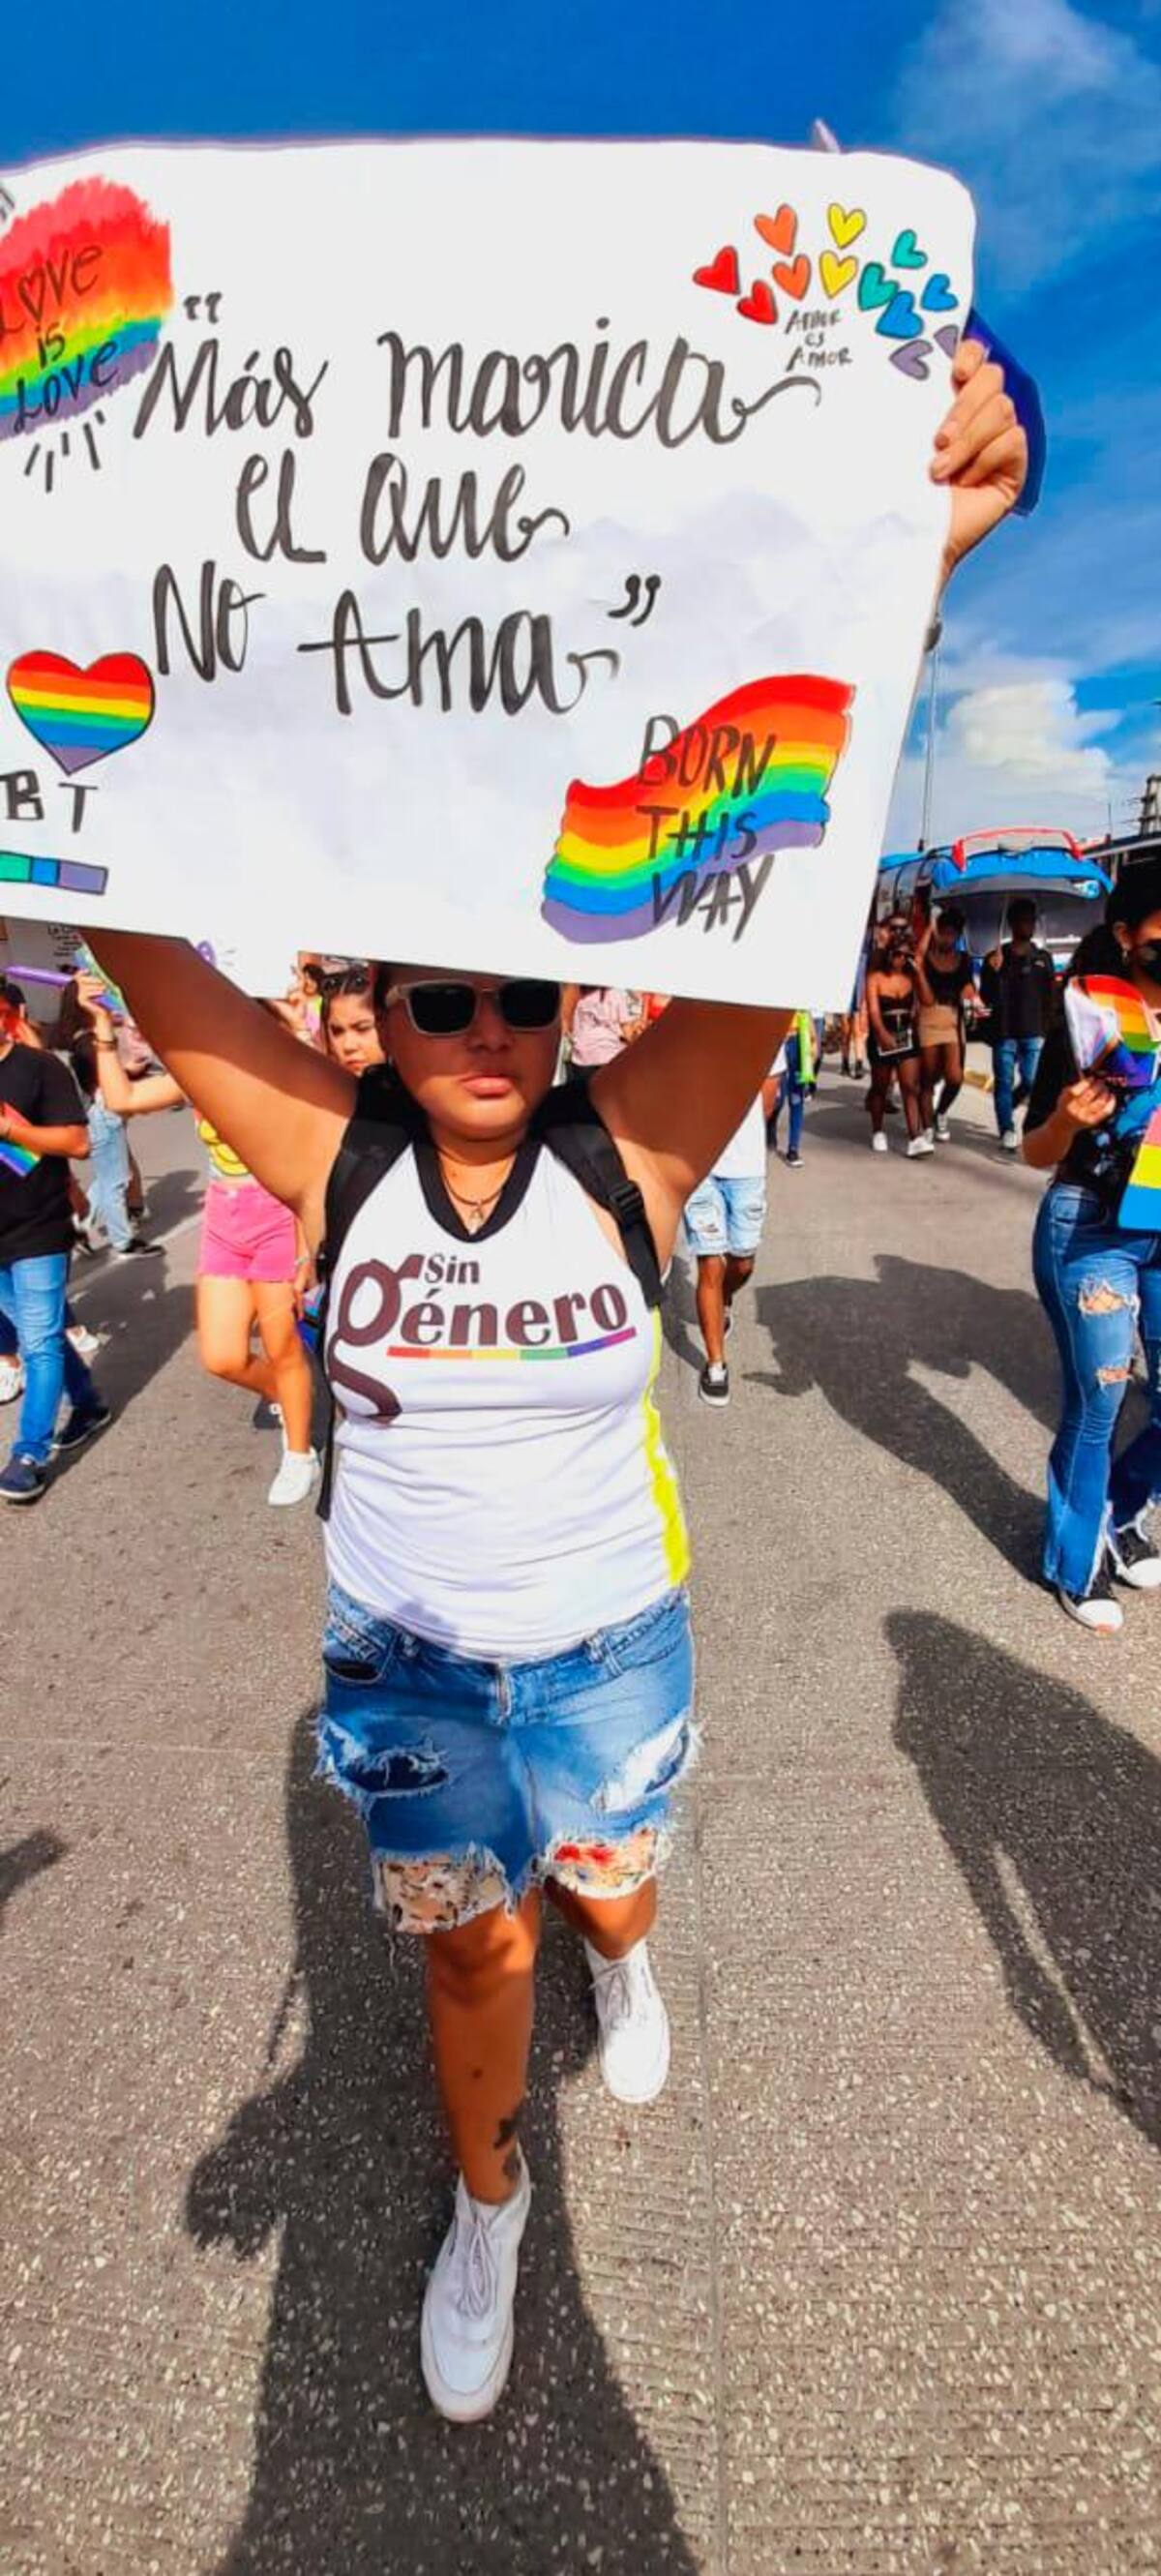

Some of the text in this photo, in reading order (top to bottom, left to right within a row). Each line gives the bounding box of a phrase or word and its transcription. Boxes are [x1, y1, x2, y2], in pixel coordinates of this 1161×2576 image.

[638, 714, 777, 799] BORN
[635, 804, 758, 860] THIS
[651, 854, 775, 944] WAY
[424, 1253, 480, 1284] Sin
